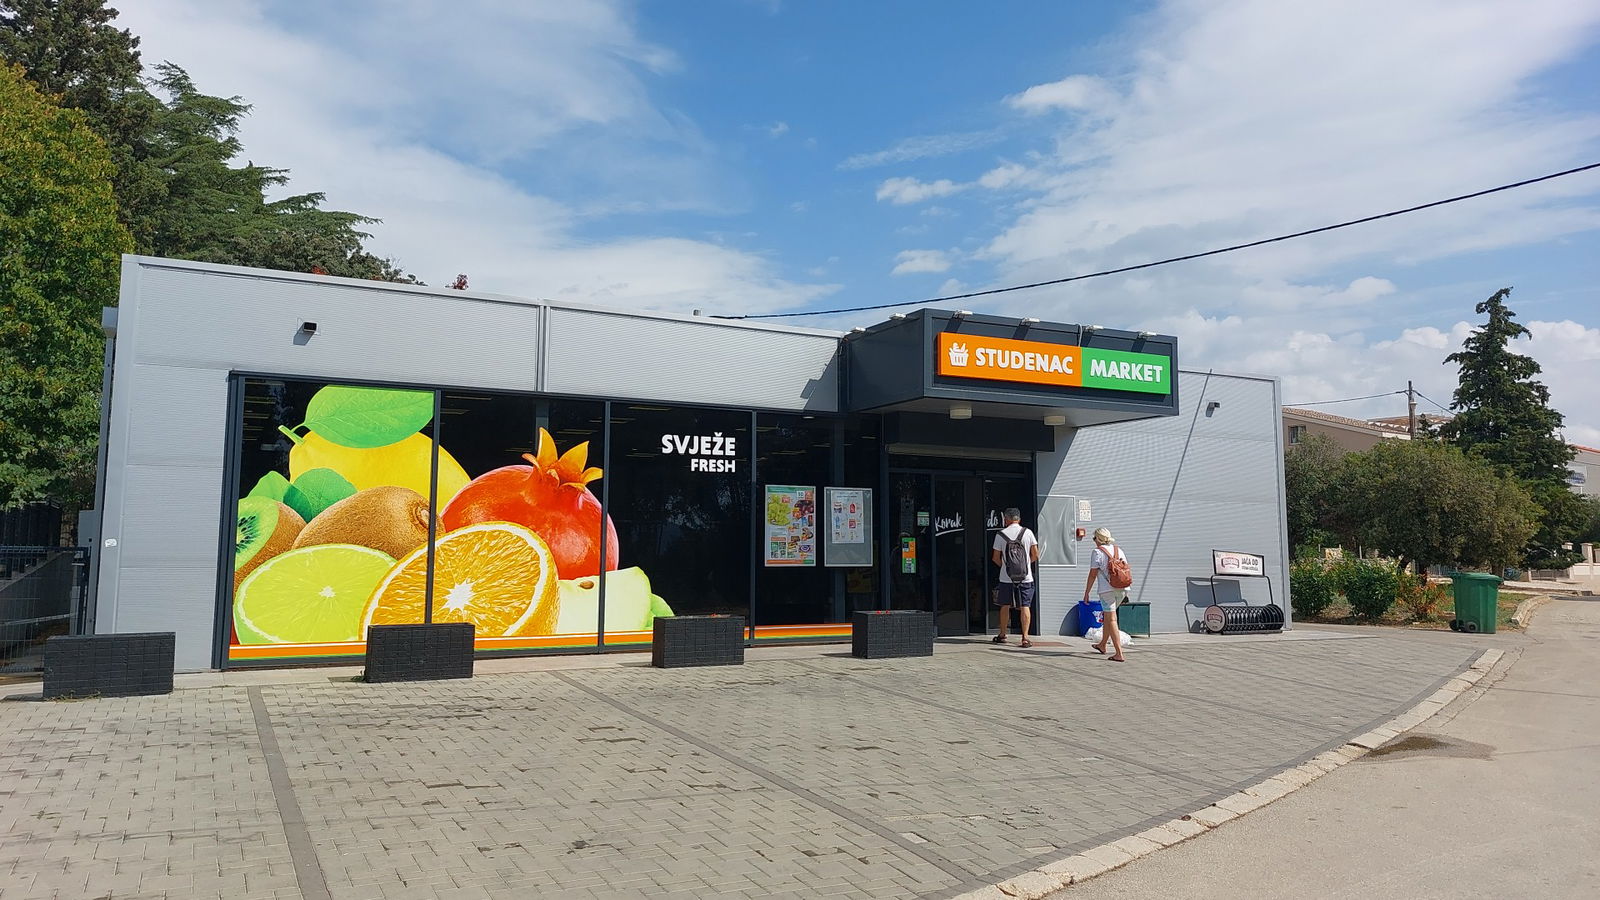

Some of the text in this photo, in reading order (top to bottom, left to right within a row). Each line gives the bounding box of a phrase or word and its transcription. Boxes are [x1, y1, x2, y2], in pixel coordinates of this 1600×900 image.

[975, 347, 1163, 383] STUDENAC MARKET
[661, 432, 736, 456] SVJEŽE
[691, 458, 736, 473] FRESH
[986, 509, 999, 528] do
